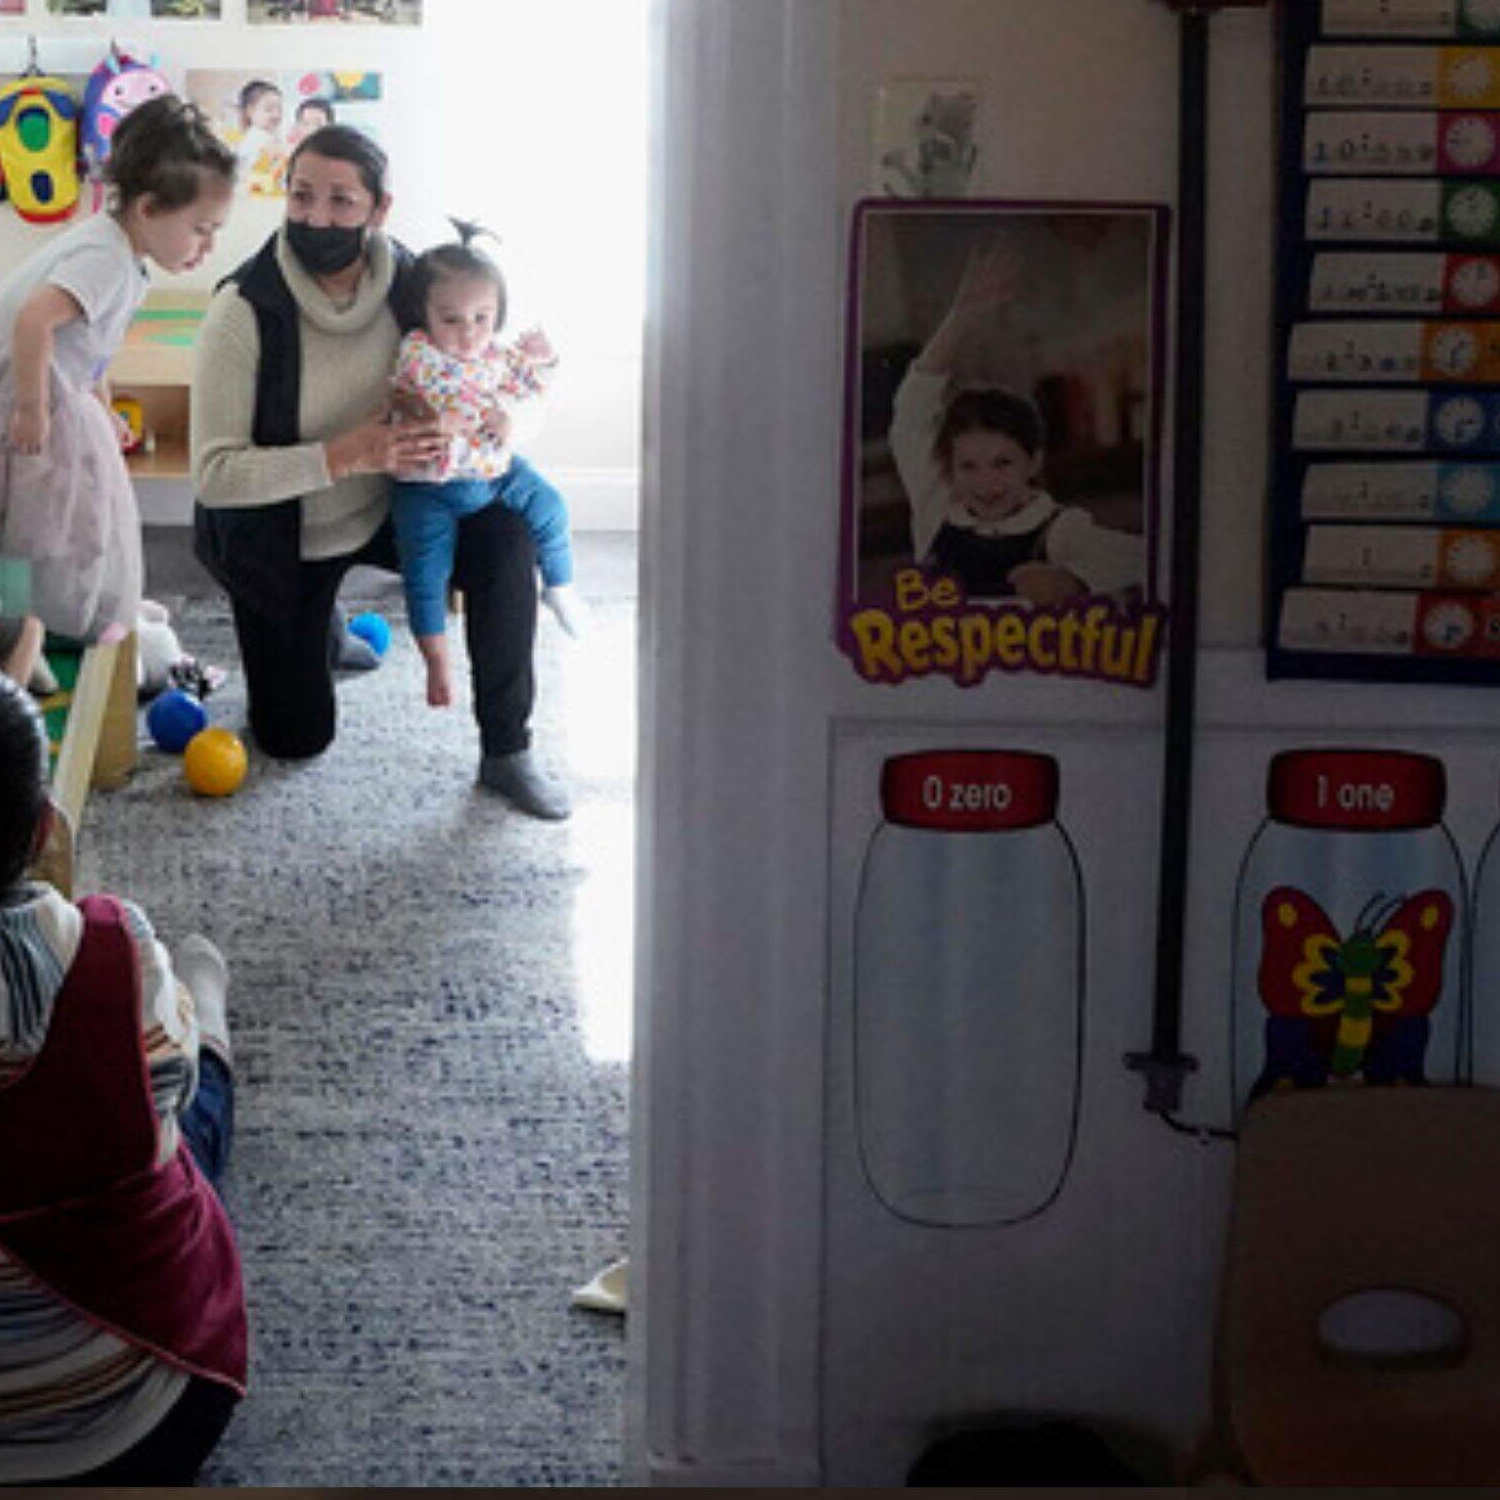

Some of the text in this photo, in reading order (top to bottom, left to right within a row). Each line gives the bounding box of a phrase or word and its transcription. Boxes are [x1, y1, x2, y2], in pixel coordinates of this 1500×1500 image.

[896, 567, 961, 612] Be
[850, 604, 1162, 682] Respectful
[922, 775, 1012, 811] 0 zero
[1316, 774, 1395, 811] 1 one
